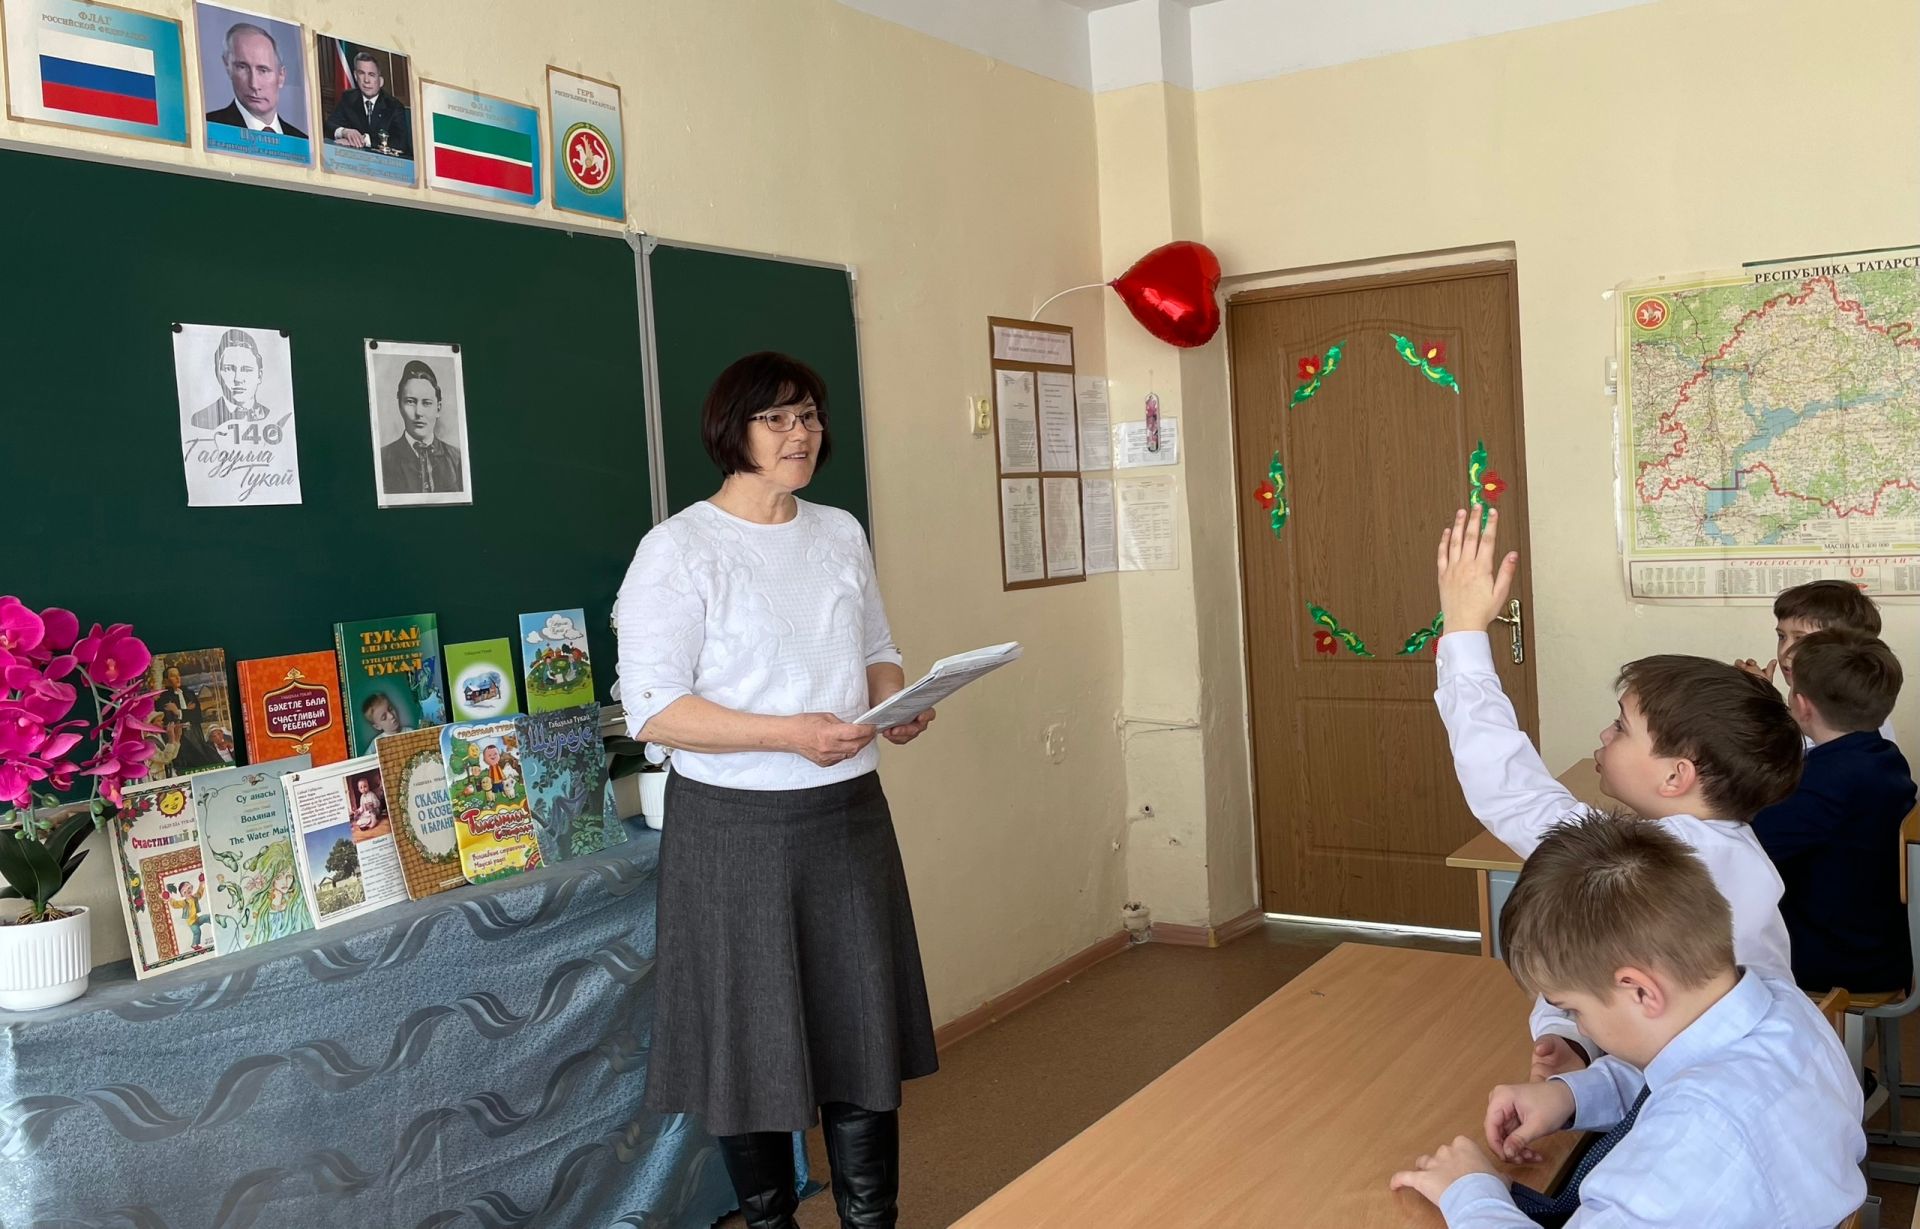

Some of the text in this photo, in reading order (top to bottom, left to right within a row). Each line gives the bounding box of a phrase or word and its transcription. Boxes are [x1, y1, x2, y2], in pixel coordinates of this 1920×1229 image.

[41, 13, 96, 31] РОССИЙСКОЙ
[78, 11, 112, 25] ФЛАГ
[576, 88, 594, 99] ГЕРБ
[1754, 264, 1850, 284] РЕСПУБЛИКА
[228, 423, 283, 446] 140
[232, 464, 294, 502] Тукай
[360, 625, 421, 645] ТУКАЙ
[365, 658, 422, 677] ТУКАЯ
[268, 697, 327, 713] БӘХЕТЛЕ БАЛА
[272, 709, 325, 725] СЧАСТЛИВЫЙ
[548, 714, 591, 729] Габдулла Тукай
[494, 723, 515, 734] ТУКА
[236, 790, 276, 804] Су анасы
[415, 789, 450, 808] СКАЗКА
[240, 811, 276, 823] Водяная
[418, 803, 452, 822] О КОЗЕ
[420, 823, 428, 835] И
[131, 829, 190, 849] Счастливый
[230, 838, 245, 846] The
[246, 831, 270, 841] Water
